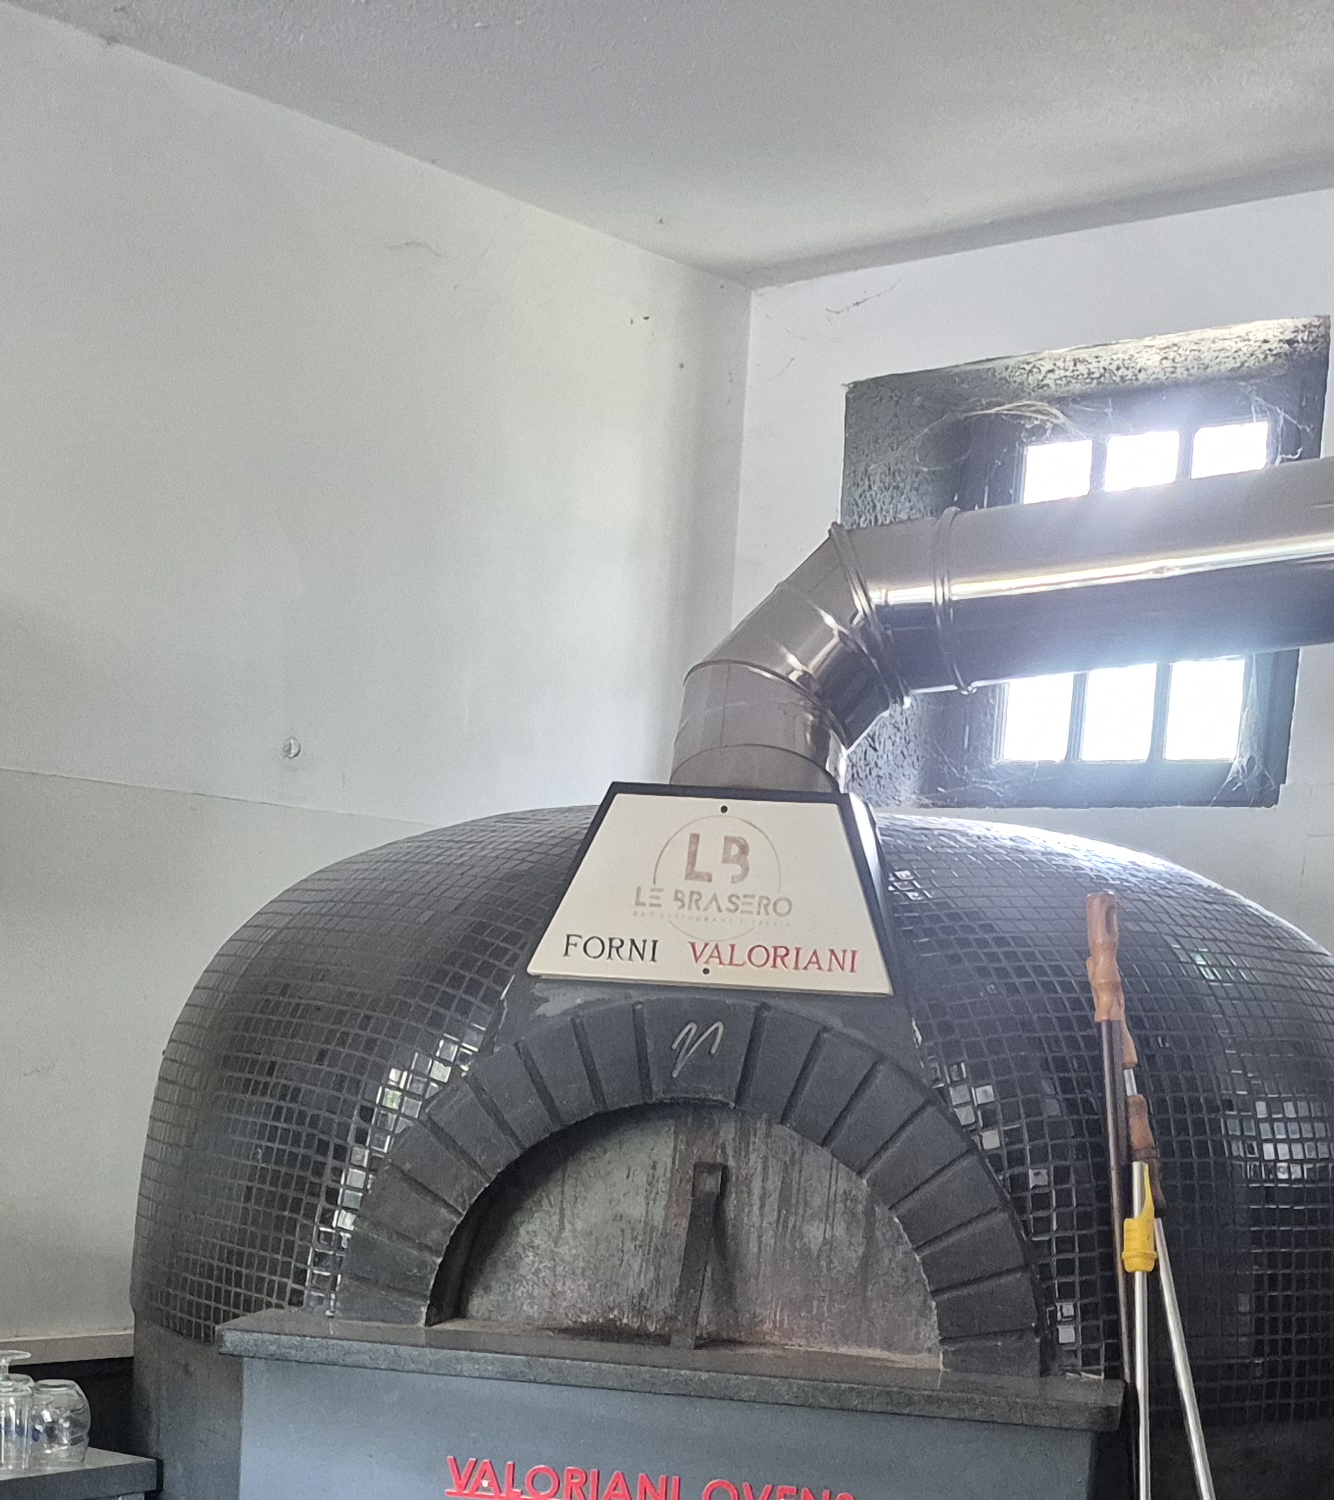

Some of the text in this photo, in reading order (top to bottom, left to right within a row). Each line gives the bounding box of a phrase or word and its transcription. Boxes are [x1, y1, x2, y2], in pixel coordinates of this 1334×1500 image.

[634, 886, 794, 917] LE BRASERO
[563, 934, 858, 974] FORNI VALORIANI
